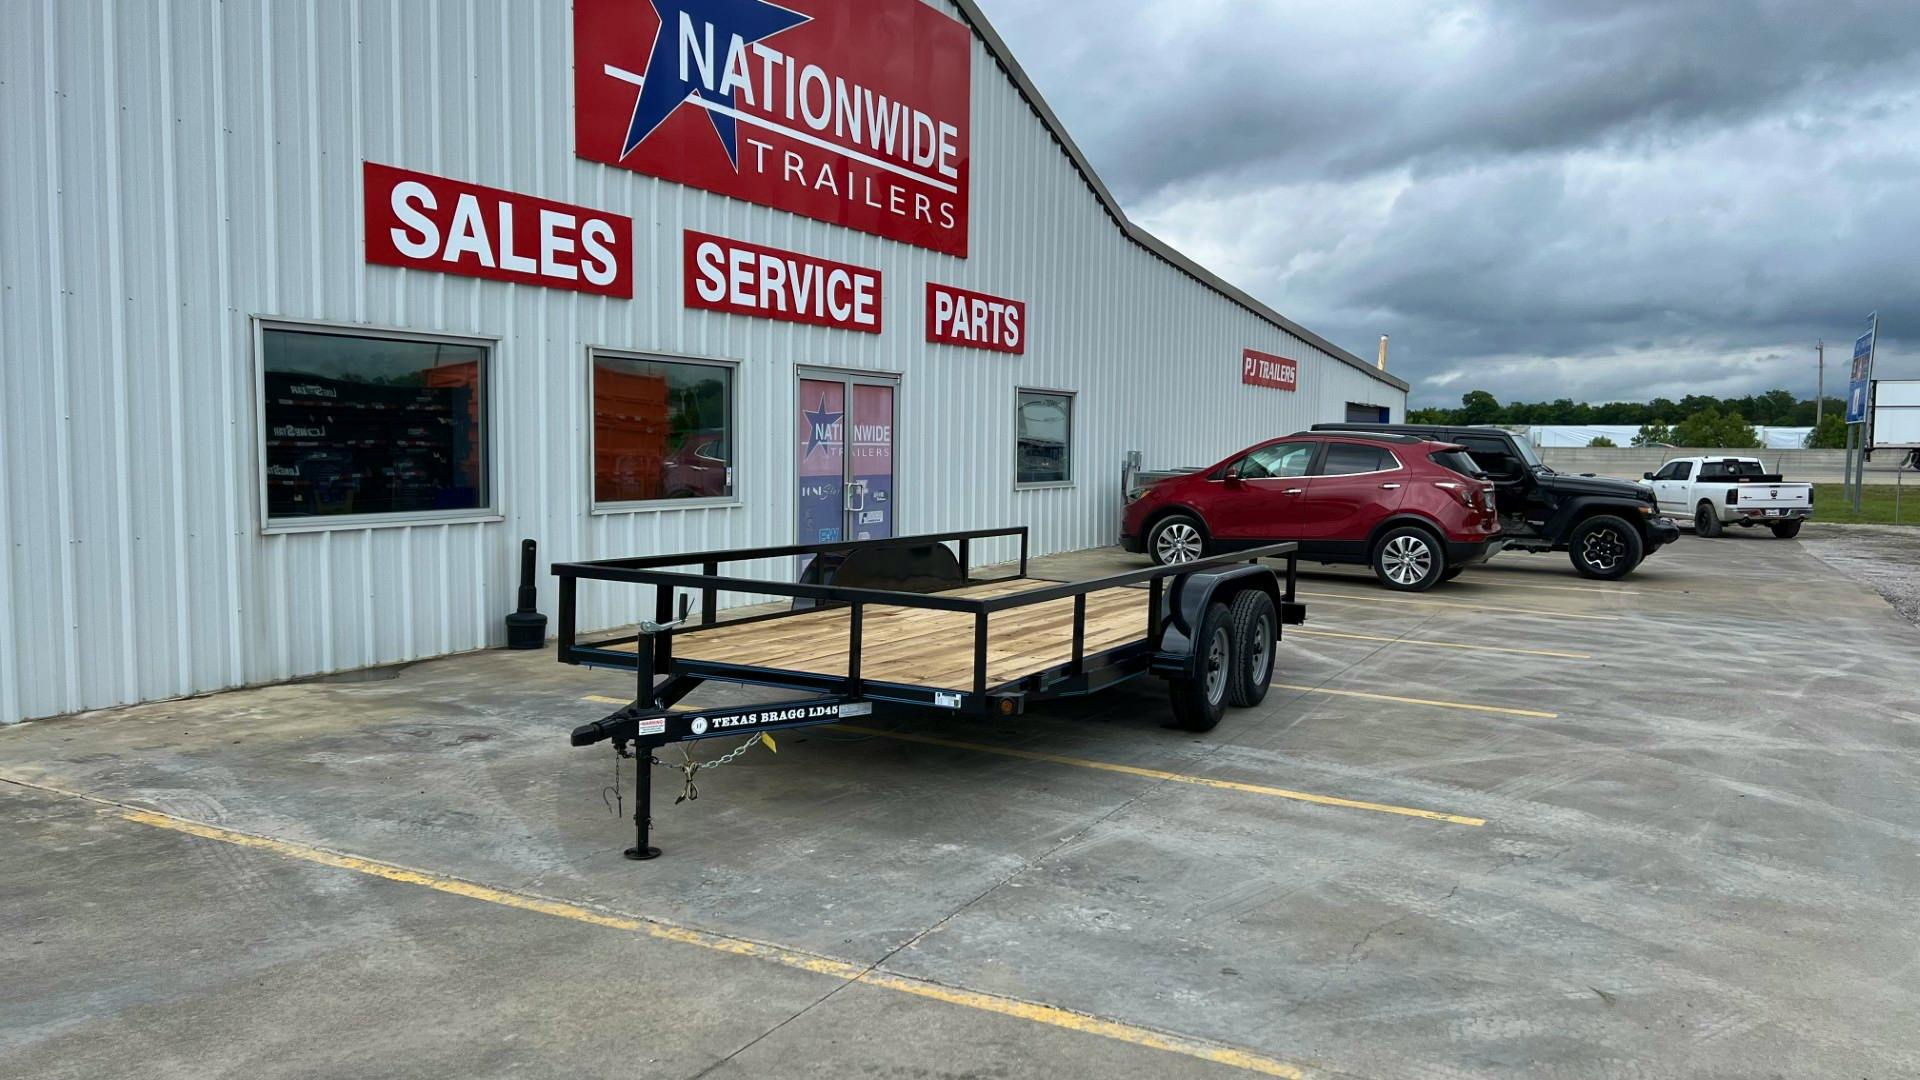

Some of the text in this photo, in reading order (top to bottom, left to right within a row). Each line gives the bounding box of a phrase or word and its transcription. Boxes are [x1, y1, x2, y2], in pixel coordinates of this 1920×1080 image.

[679, 9, 959, 179] NATIONWIDE
[746, 138, 956, 230] TRAILERS
[389, 180, 618, 286] SALES
[696, 242, 876, 326] SERVICE
[935, 290, 1019, 348] PARTS
[1244, 357, 1296, 384] PJ TRAILERS
[815, 423, 890, 442] NATINWIDE
[712, 714, 757, 728] TEXAS
[760, 708, 806, 723] BRAGG
[808, 705, 838, 717] LD45
